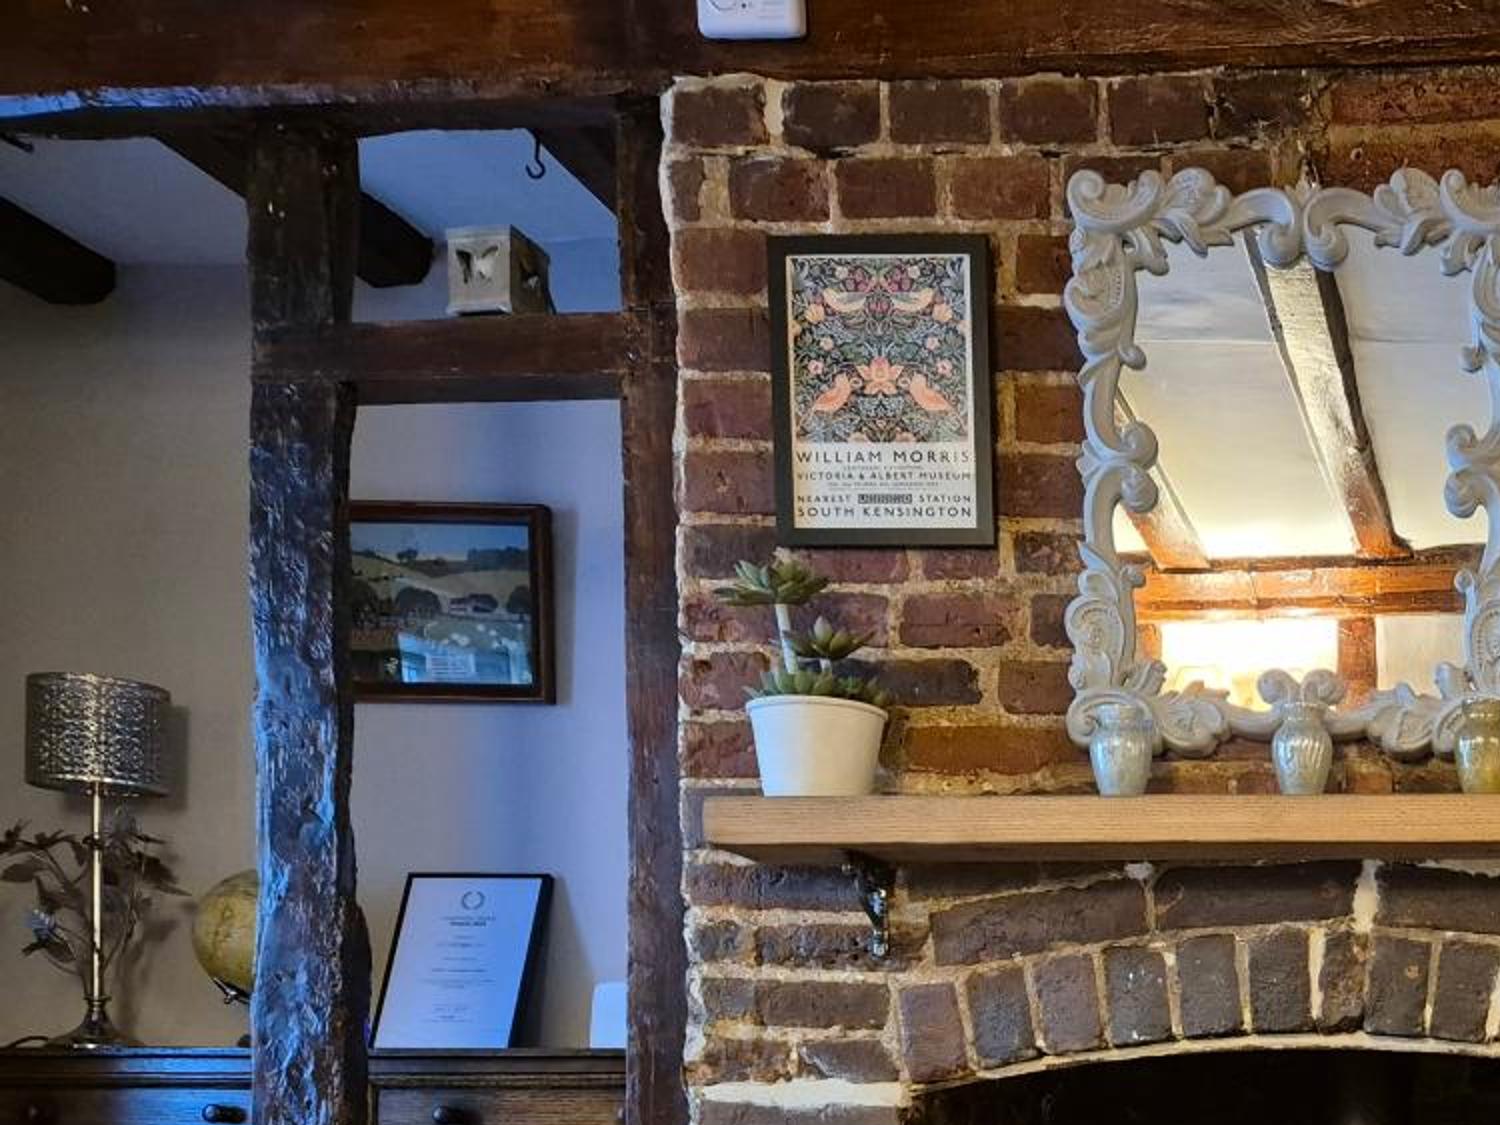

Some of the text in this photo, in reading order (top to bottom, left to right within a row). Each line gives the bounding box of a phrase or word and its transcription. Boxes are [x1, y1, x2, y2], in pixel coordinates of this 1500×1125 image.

[796, 450, 970, 463] WILLIAM MORRIS
[797, 471, 854, 481] VICTORIA
[870, 471, 914, 481] ALBERT
[919, 471, 972, 481] MUSEUM
[797, 495, 851, 503] NEAREST
[919, 494, 972, 503] STATION
[797, 506, 972, 518] SOUTH KENSINGTON
